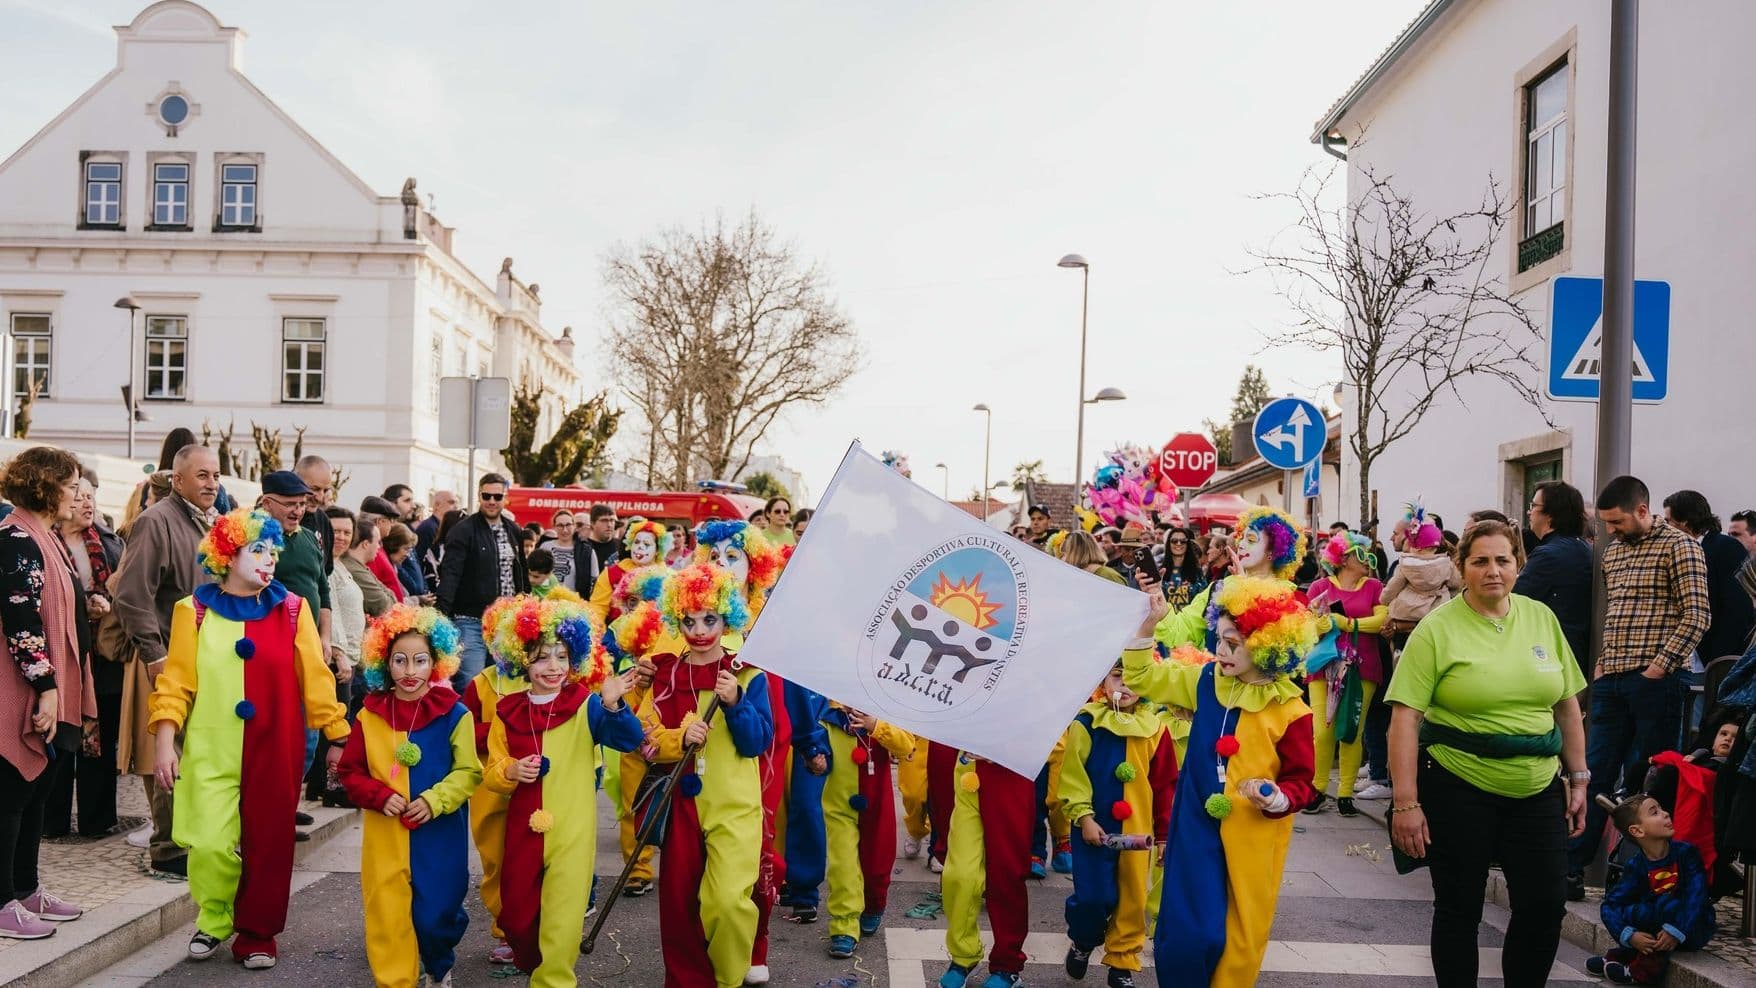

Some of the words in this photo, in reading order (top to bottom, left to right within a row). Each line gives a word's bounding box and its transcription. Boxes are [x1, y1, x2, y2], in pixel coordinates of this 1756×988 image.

[1163, 450, 1215, 470] STOP
[528, 498, 591, 509] BOMBEIROS
[866, 580, 906, 640] ASSOCIAÇÃO
[903, 539, 965, 581] DESPORTIVA
[966, 536, 1020, 570] CULTURAL
[1010, 582, 1028, 647] RECREATIVA
